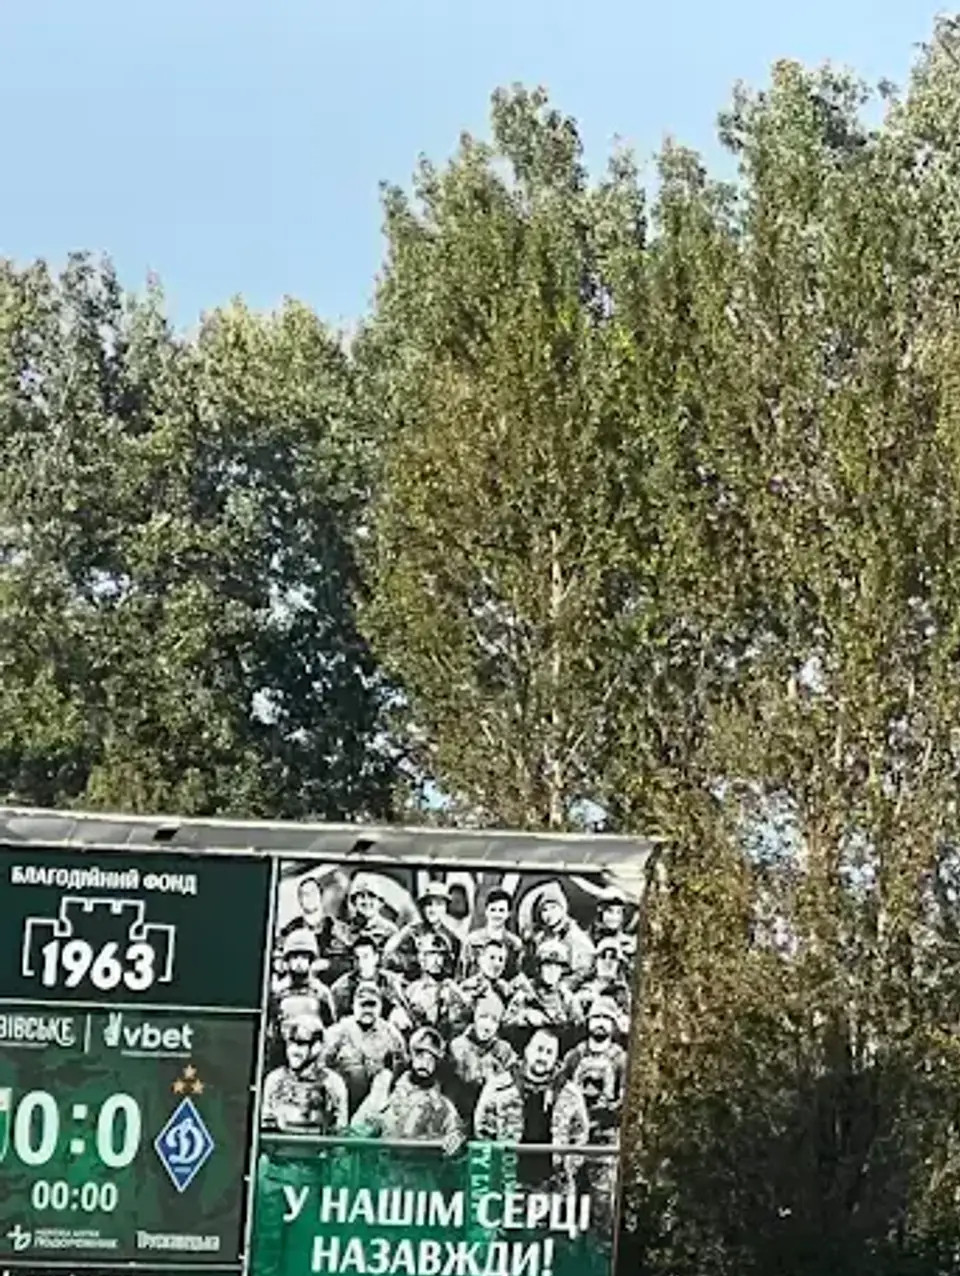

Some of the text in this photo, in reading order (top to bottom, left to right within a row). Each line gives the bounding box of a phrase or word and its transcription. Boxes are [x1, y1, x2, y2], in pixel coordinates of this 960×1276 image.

[11, 865, 198, 895] БЛАГОДІЙНИЙ ФОНД
[42, 939, 155, 991] 1963
[123, 1023, 193, 1049] vbet
[32, 1180, 118, 1211] 00:00
[283, 1186, 591, 1240] У НАШІМ СЕРЦІ
